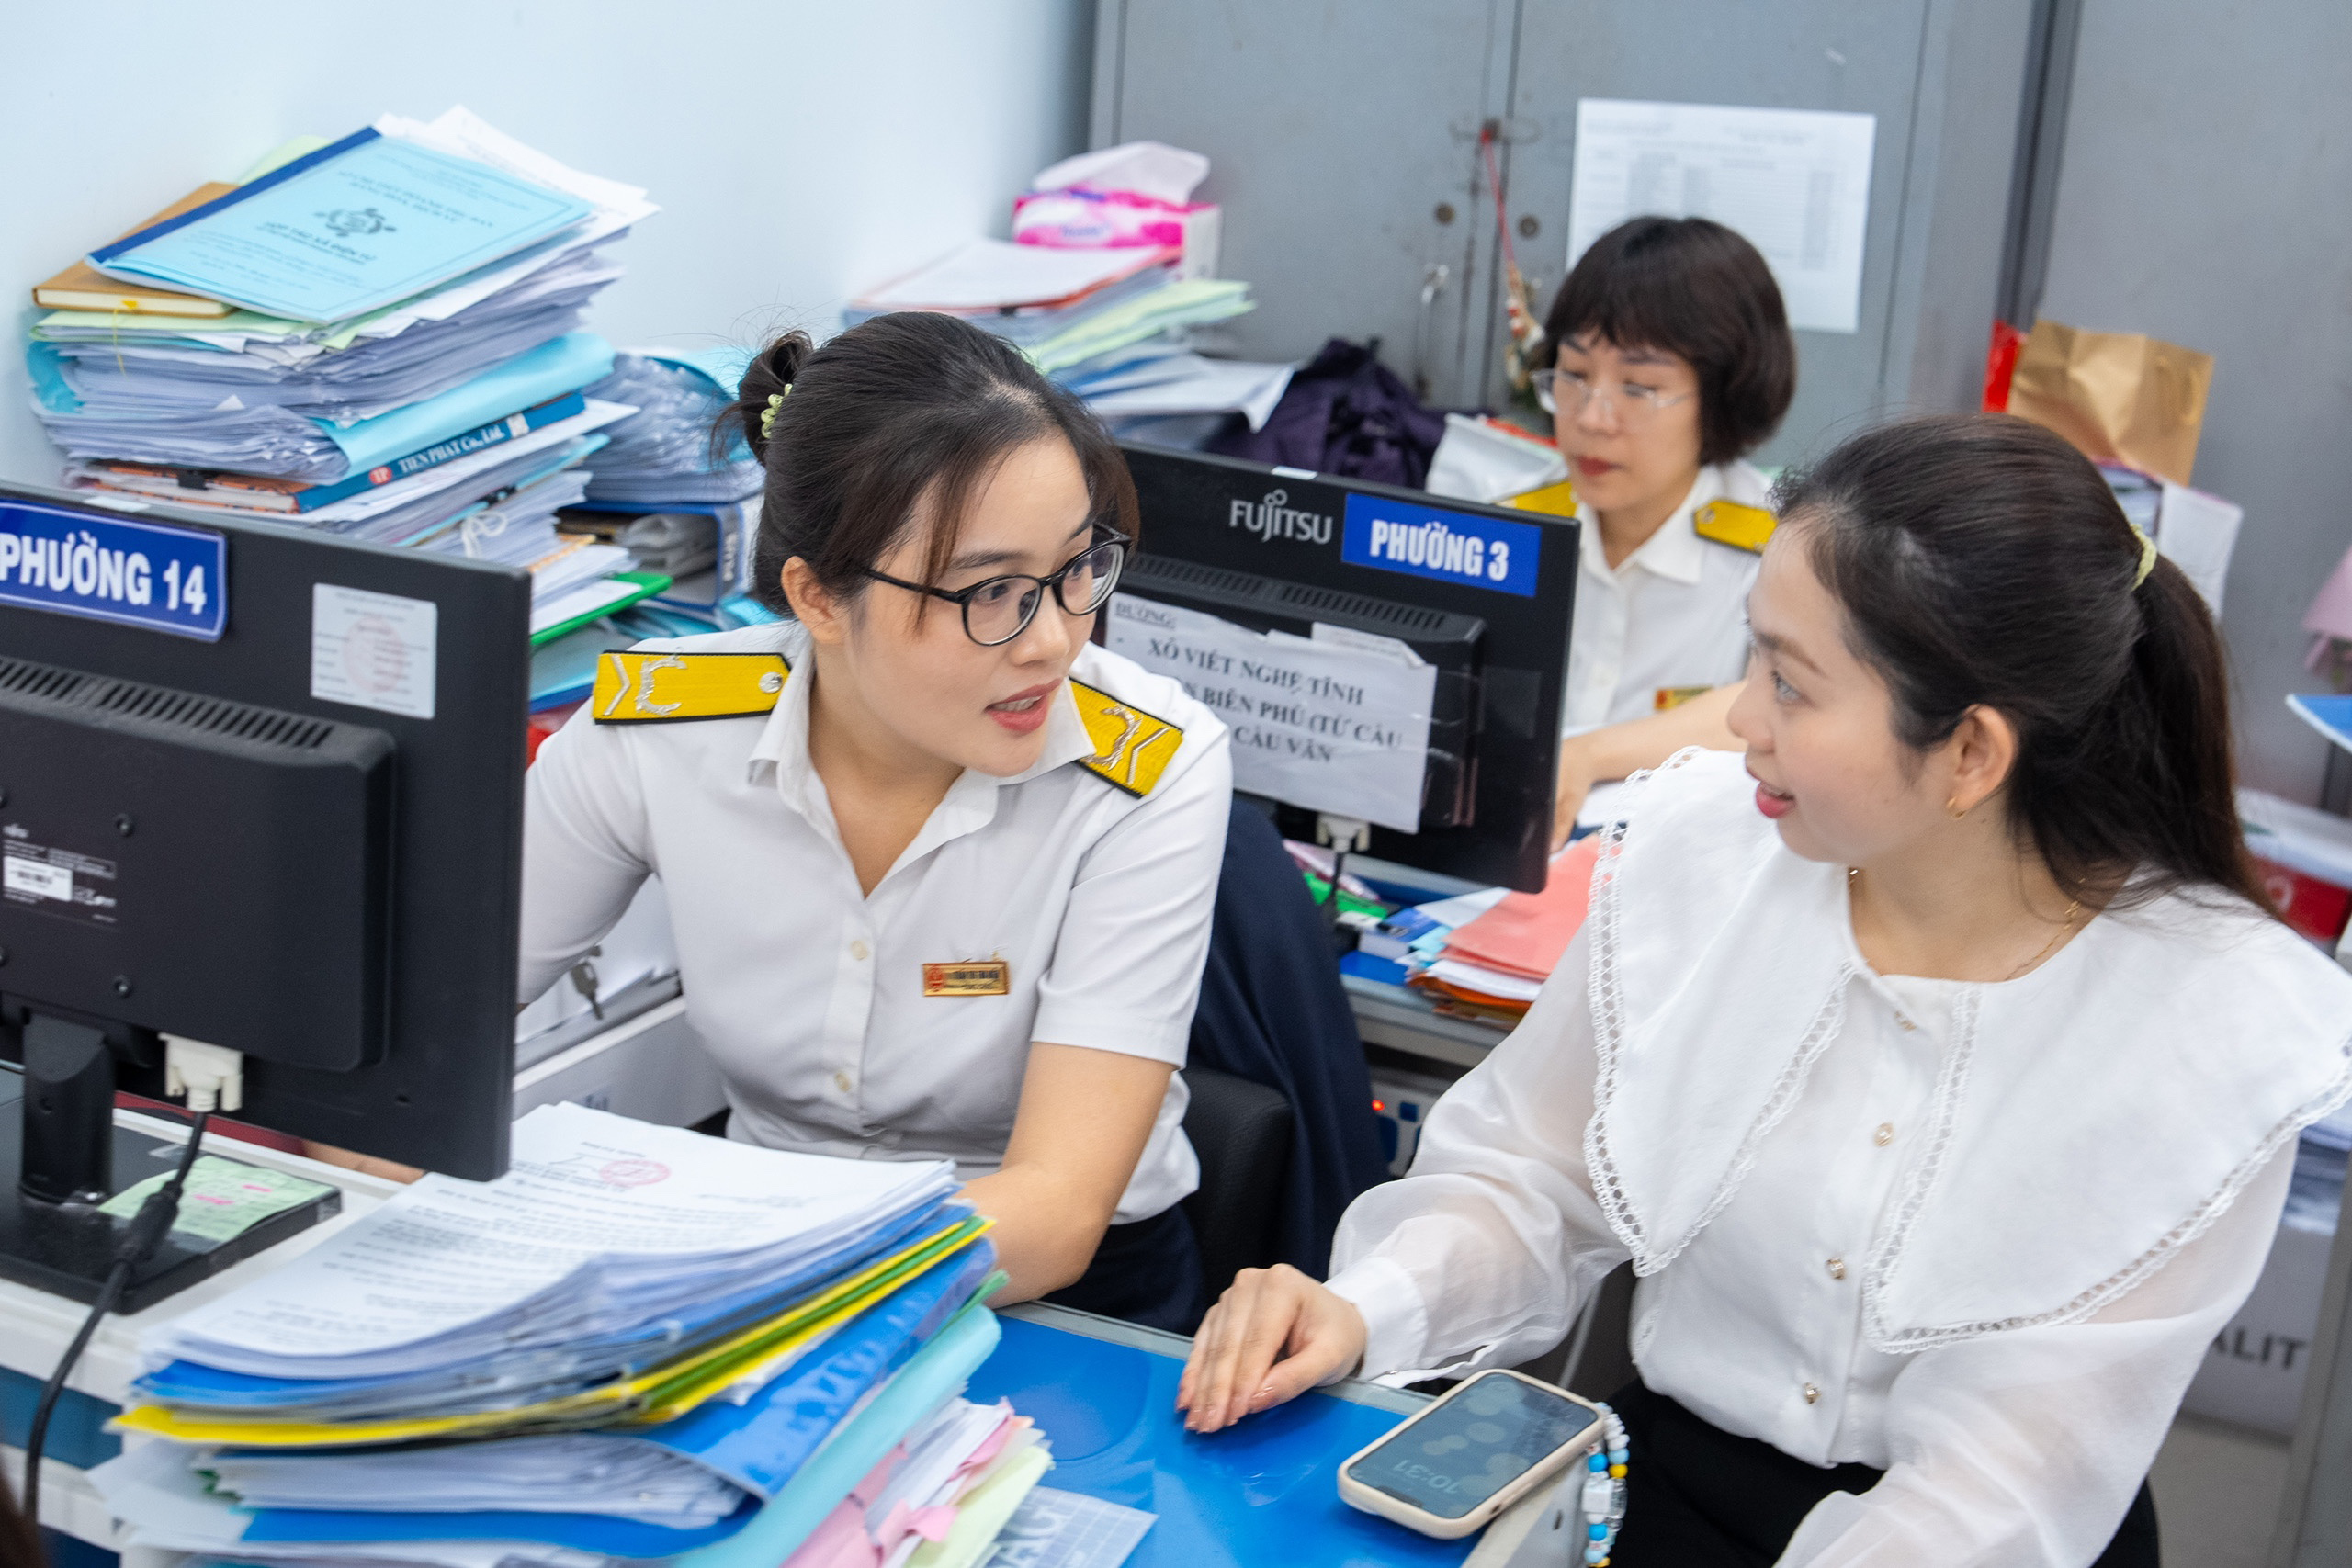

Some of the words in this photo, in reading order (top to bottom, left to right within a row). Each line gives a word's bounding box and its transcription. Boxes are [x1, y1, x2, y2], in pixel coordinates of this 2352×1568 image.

[1229, 489, 1333, 545] FUJITSU
[0, 530, 152, 605] PHƯỜNG
[164, 559, 208, 615] 14
[1369, 519, 1485, 577] PHƯỜNG
[1487, 540, 1510, 581] 3
